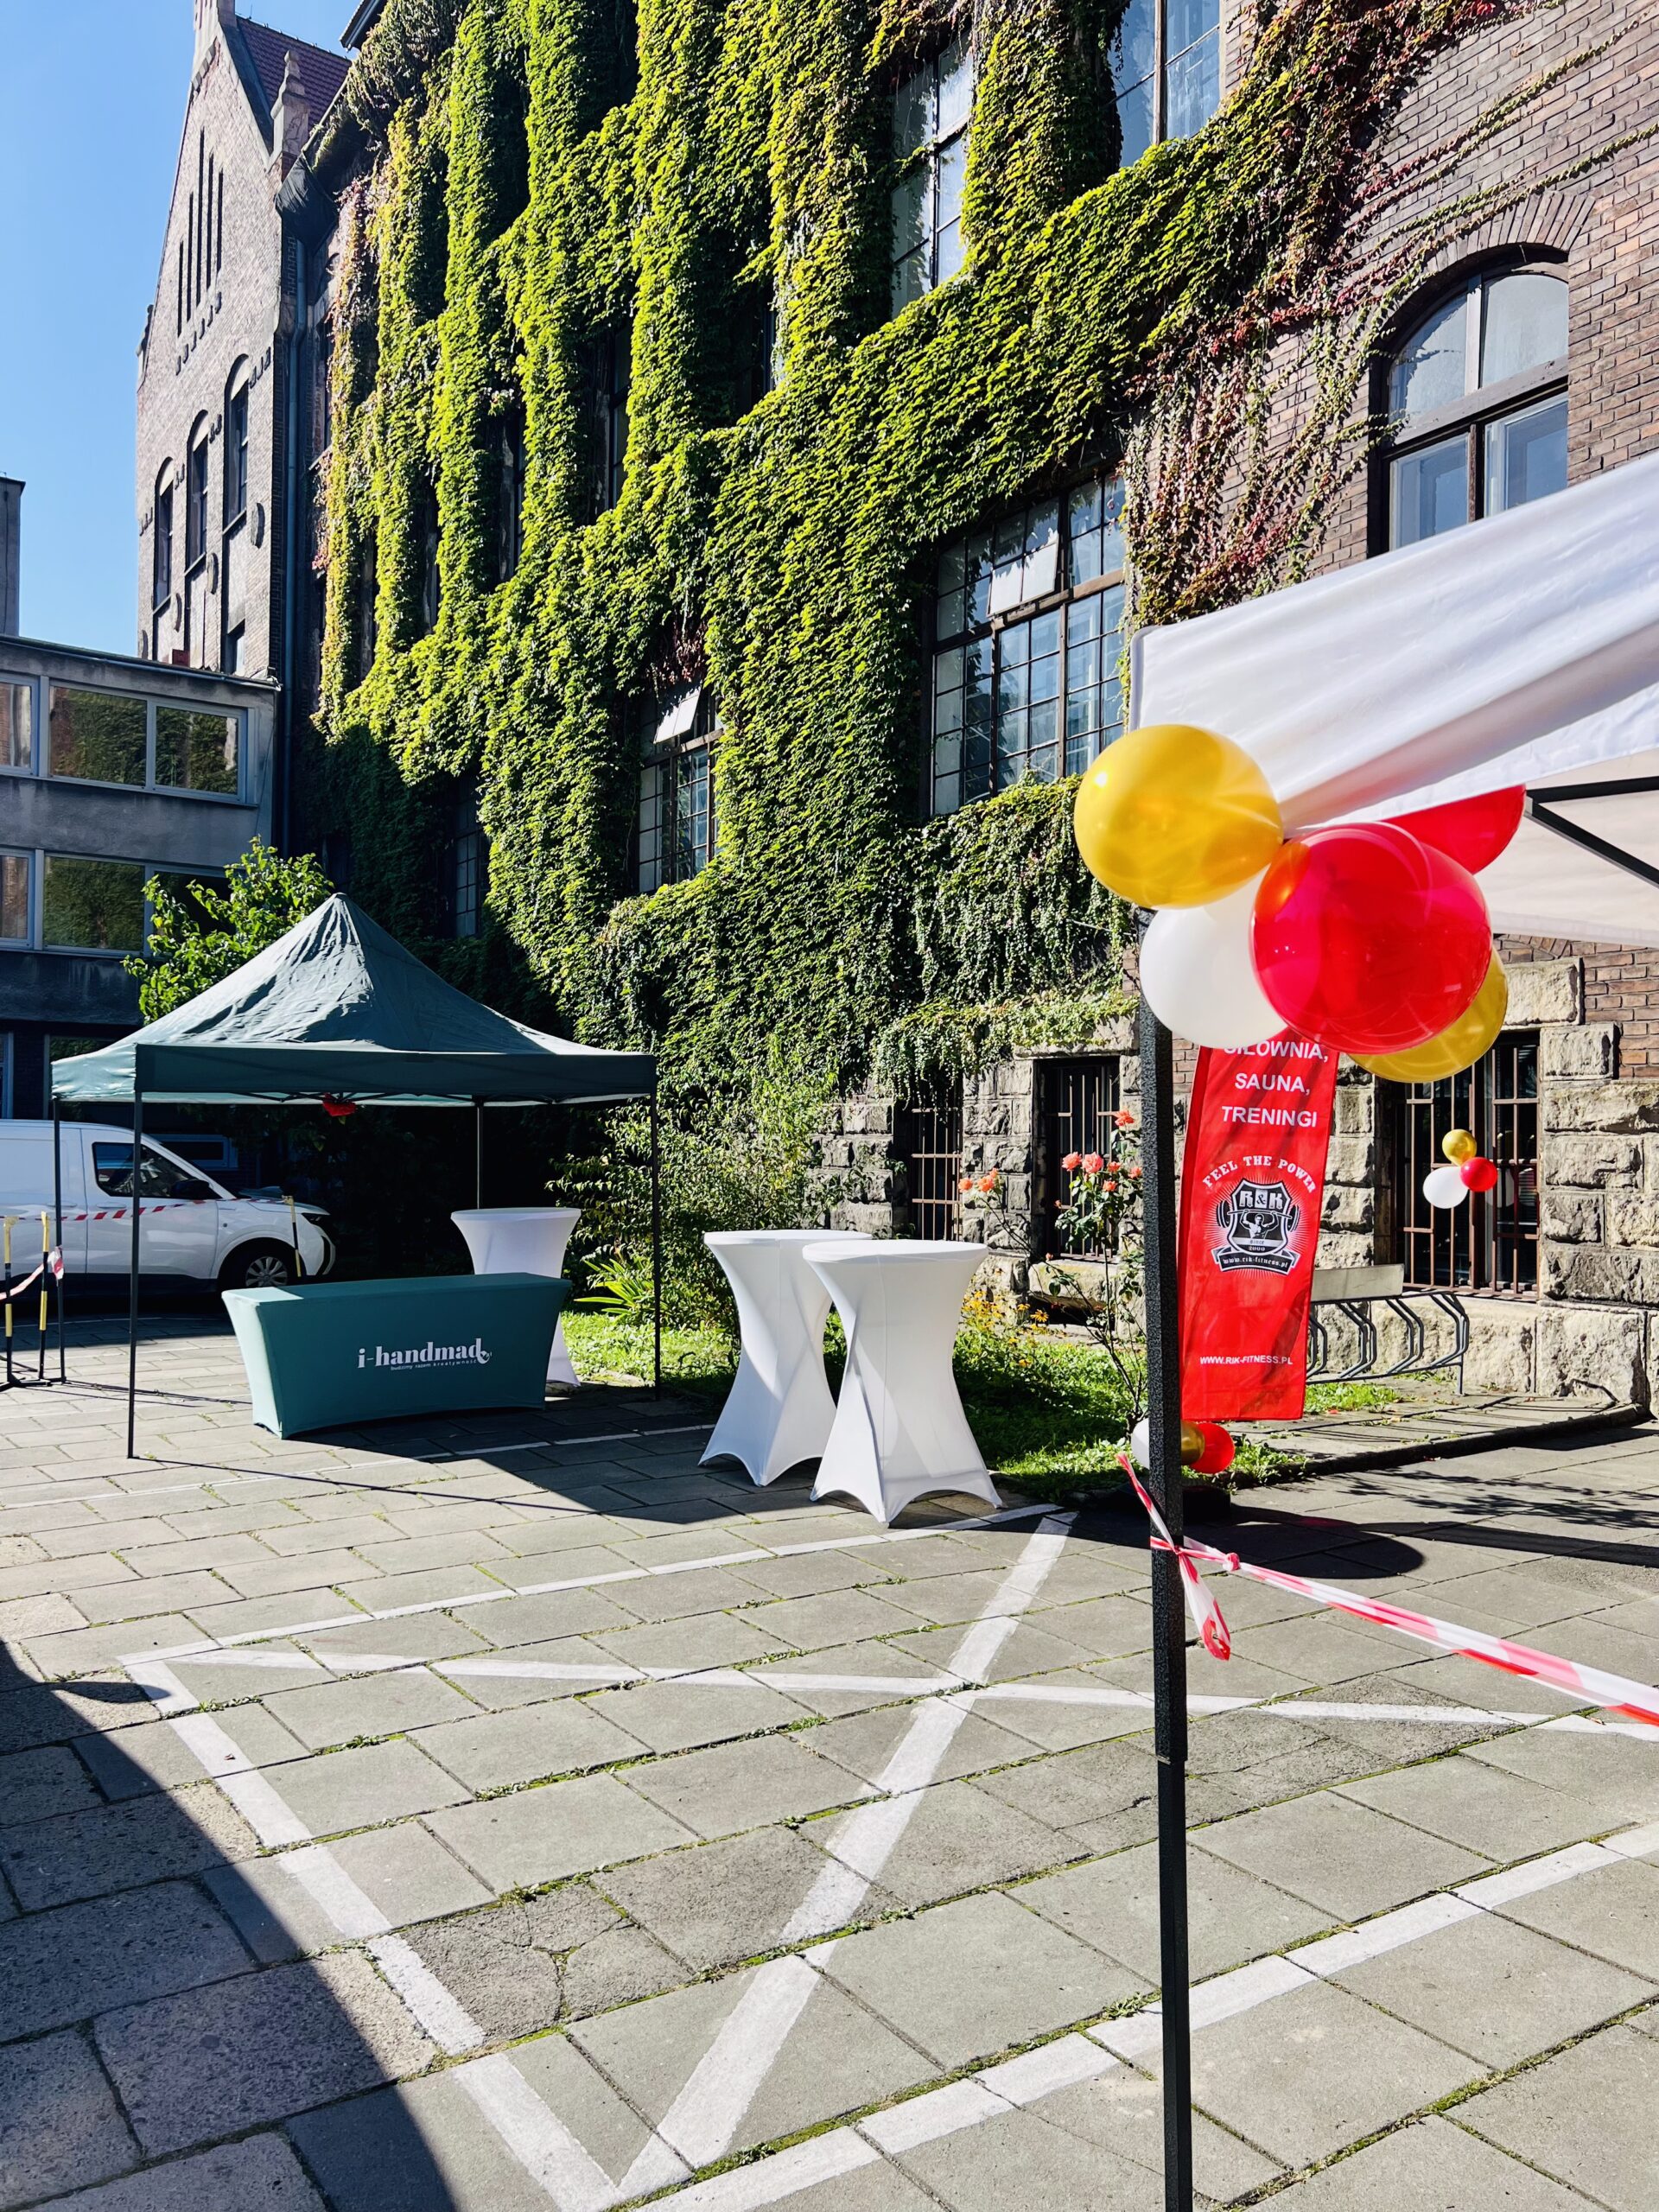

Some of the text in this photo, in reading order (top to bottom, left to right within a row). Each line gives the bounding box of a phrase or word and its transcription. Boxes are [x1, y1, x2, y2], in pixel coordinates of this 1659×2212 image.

[1235, 1073, 1310, 1096] SAUNA,
[1222, 1106, 1318, 1128] TRENINGI
[1202, 1155, 1317, 1193] FEEL THE POWER
[1199, 1355, 1293, 1365] WWW.RIK-FITNESS.PL
